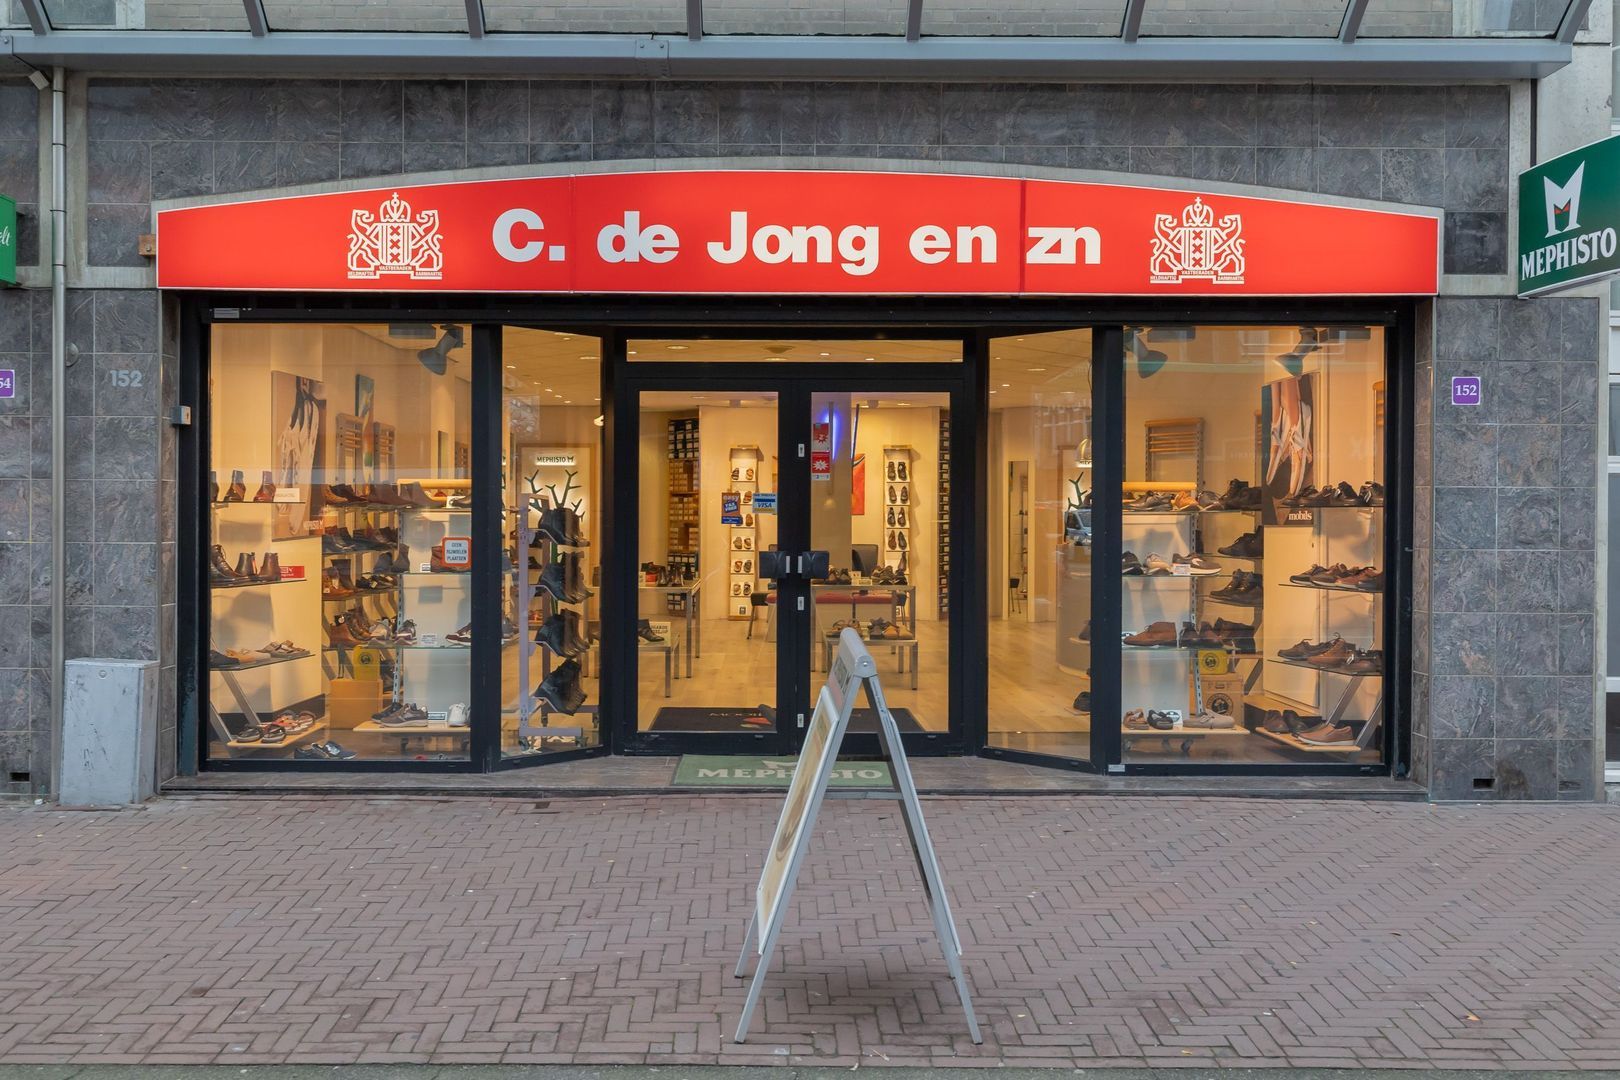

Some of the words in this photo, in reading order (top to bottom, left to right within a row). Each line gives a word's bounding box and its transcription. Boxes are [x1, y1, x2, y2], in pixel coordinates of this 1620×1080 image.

[493, 208, 566, 263] C.
[597, 210, 680, 263] de
[707, 211, 880, 276] Jong
[909, 225, 998, 264] en
[1026, 226, 1101, 265] zn
[1521, 227, 1617, 281] MEPHISTO
[110, 370, 143, 387] 152
[1455, 384, 1477, 396] 152
[1288, 510, 1312, 520] mobils
[698, 768, 883, 778] MEPHSTO
